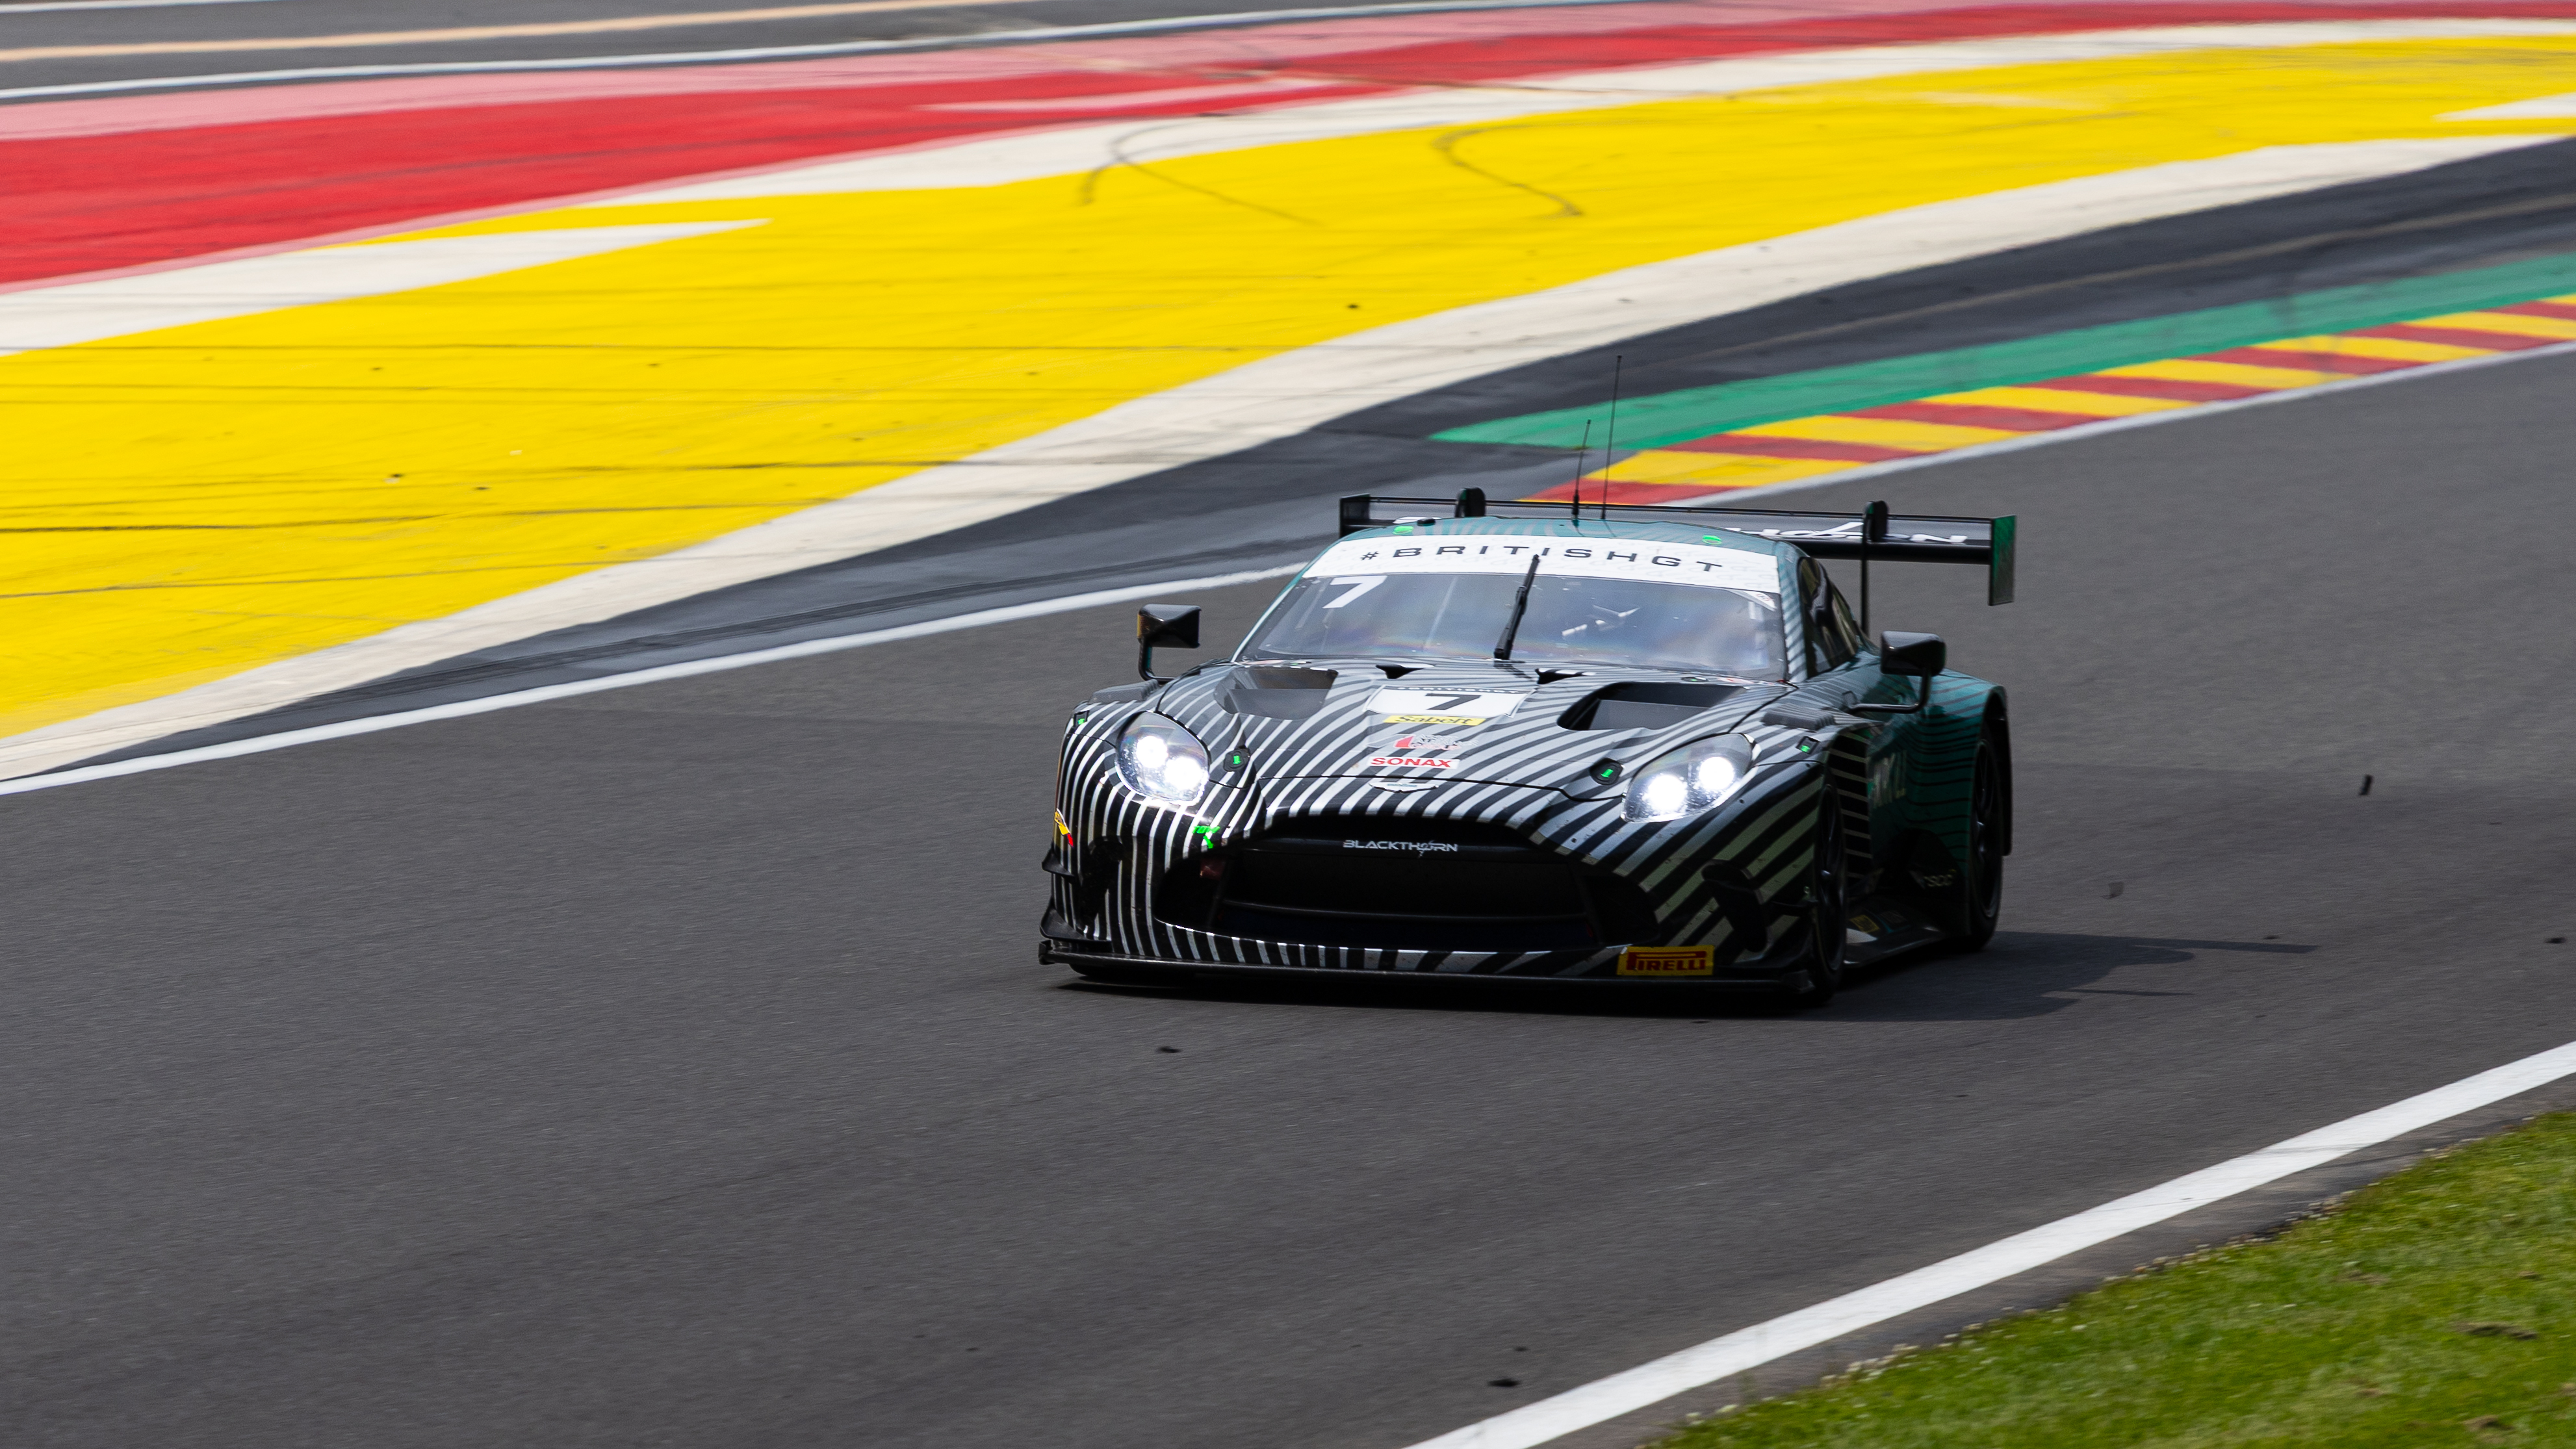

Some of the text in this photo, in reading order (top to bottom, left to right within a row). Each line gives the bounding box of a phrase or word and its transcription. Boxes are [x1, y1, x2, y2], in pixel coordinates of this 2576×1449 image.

[1360, 546, 1723, 572] #BRITISHGT
[1322, 576, 1388, 609] 7
[1425, 693, 1482, 711] 7
[1395, 715, 1473, 725] Sabelt
[1371, 758, 1452, 768] SONAX
[1343, 840, 1458, 854] BLACKTHORN
[1626, 951, 1707, 971] PIRELLI
